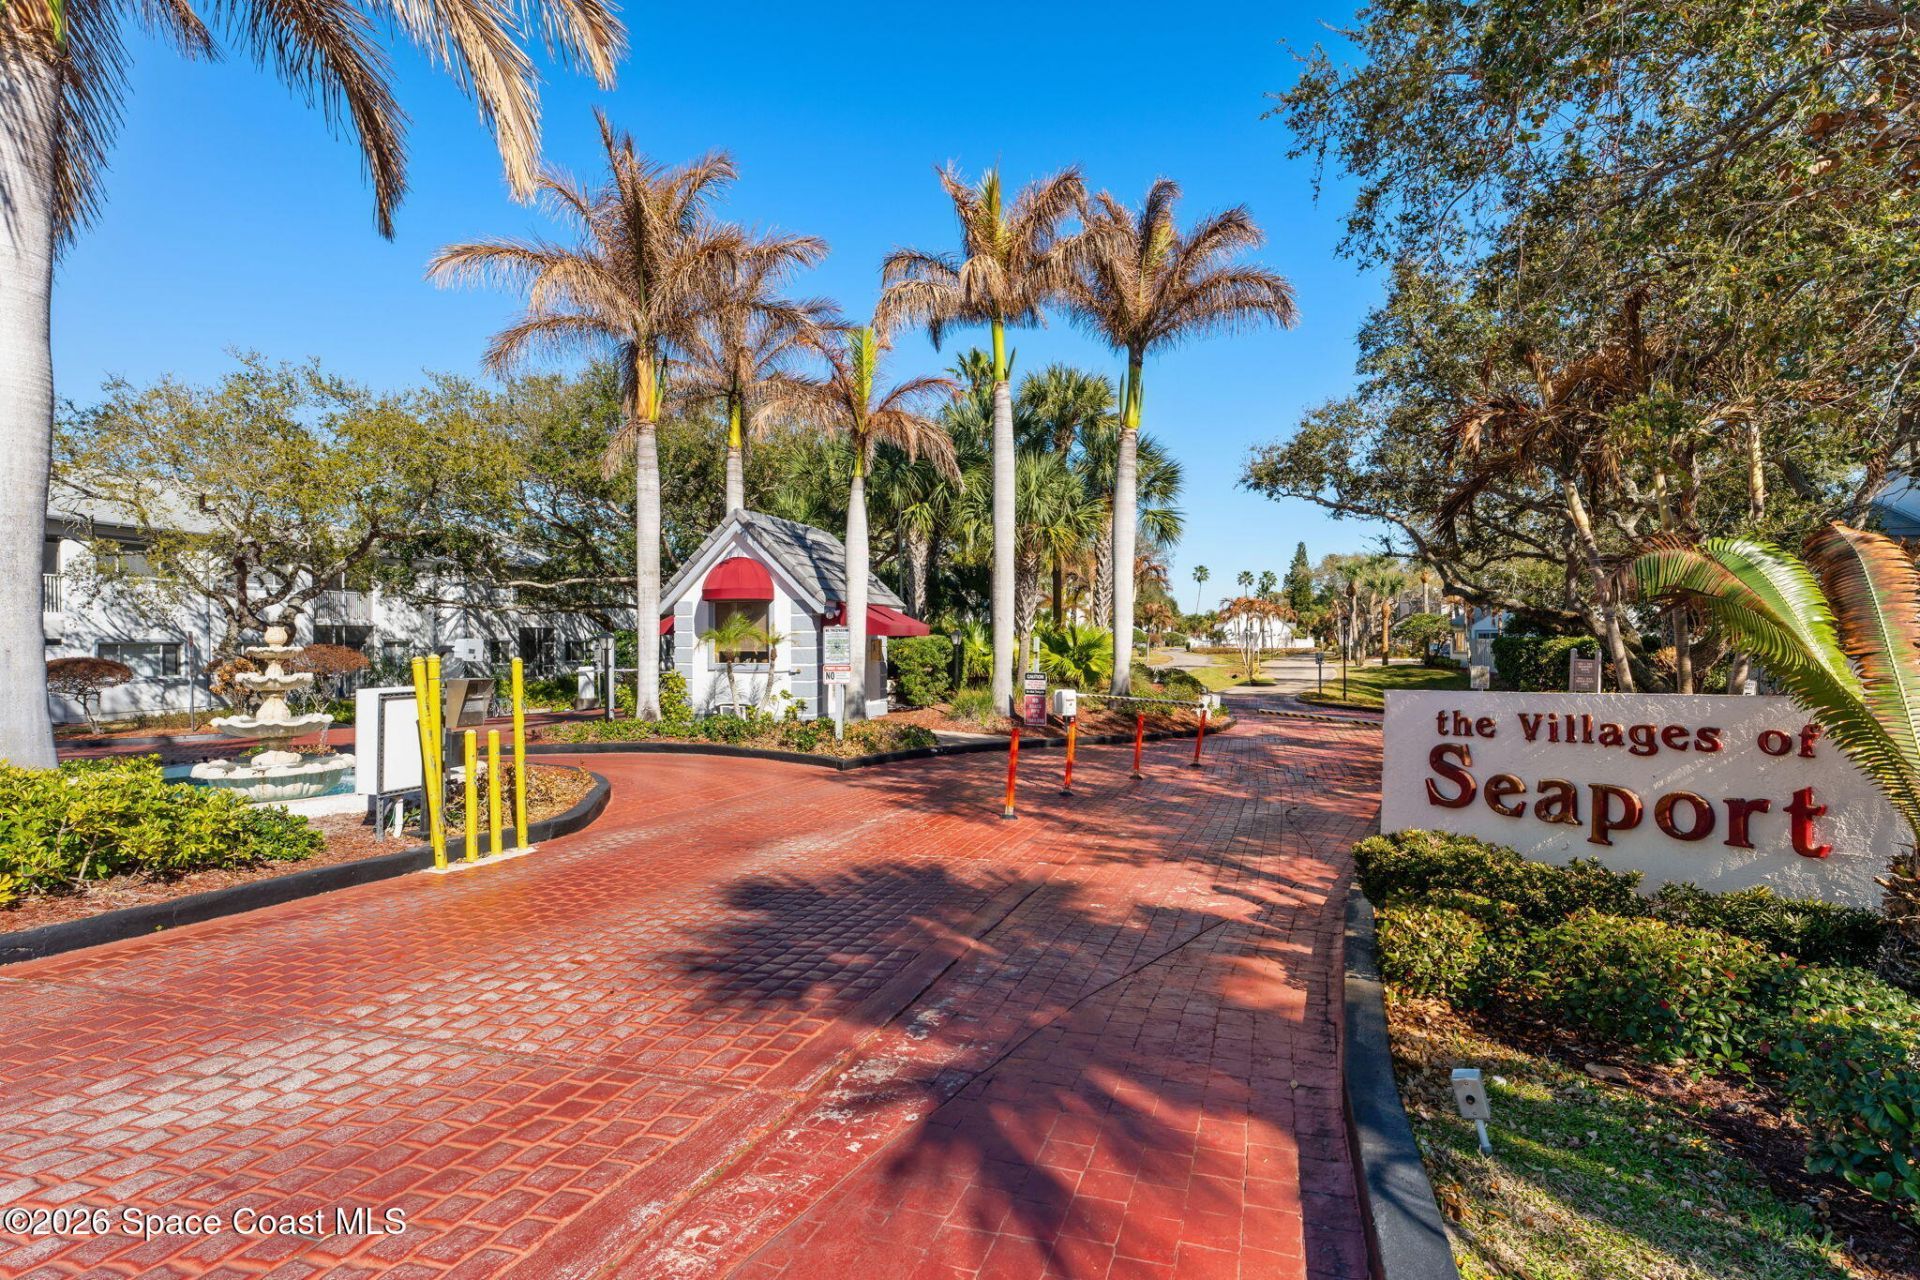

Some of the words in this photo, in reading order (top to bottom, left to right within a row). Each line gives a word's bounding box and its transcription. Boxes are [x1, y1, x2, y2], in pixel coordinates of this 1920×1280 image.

[826, 672, 835, 680] NO
[1436, 709, 1496, 739] the
[1518, 711, 1723, 757] Villages
[1757, 723, 1822, 759] of
[1425, 742, 1833, 859] Seaport
